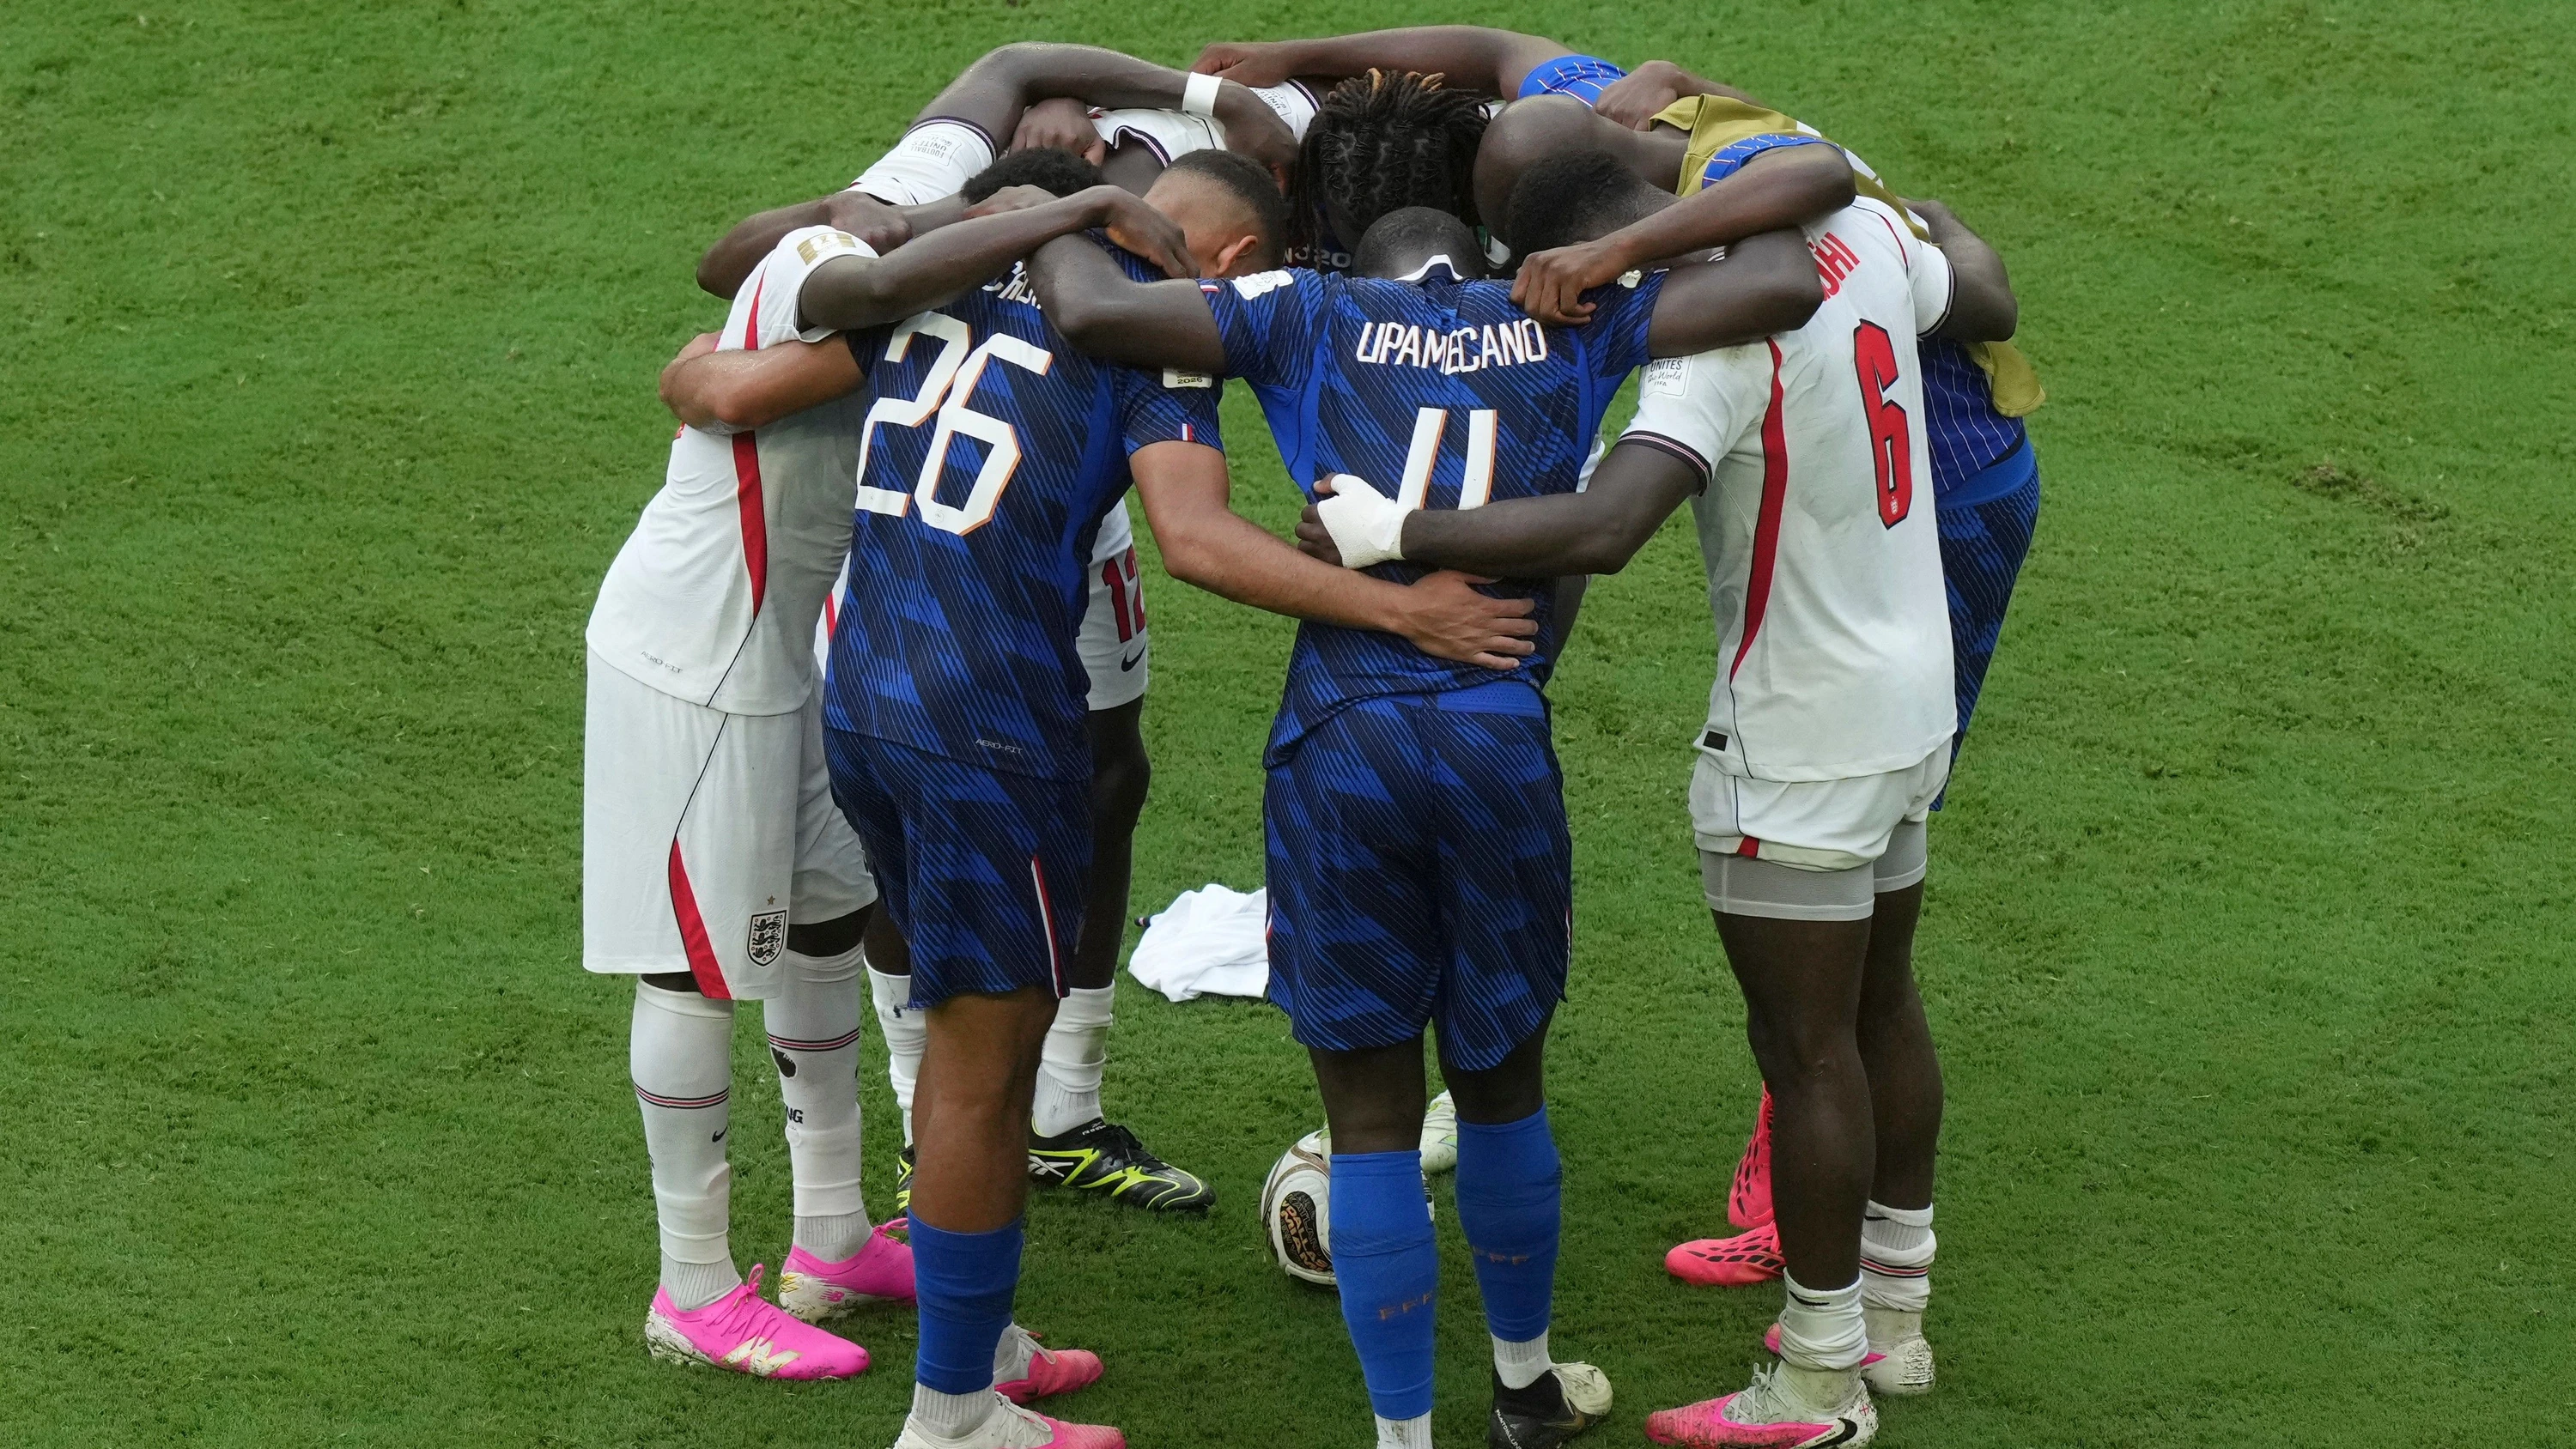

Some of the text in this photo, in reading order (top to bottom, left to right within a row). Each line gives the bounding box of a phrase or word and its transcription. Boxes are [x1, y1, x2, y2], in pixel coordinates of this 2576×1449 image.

[1356, 317, 1548, 376] UPAMECANO
[1649, 359, 1684, 373] UNITES
[1657, 370, 1683, 383] World
[854, 310, 1054, 537] 26
[1853, 318, 1913, 530] 6
[1101, 543, 1147, 644] 12
[975, 738, 1024, 755] AERO-FIT
